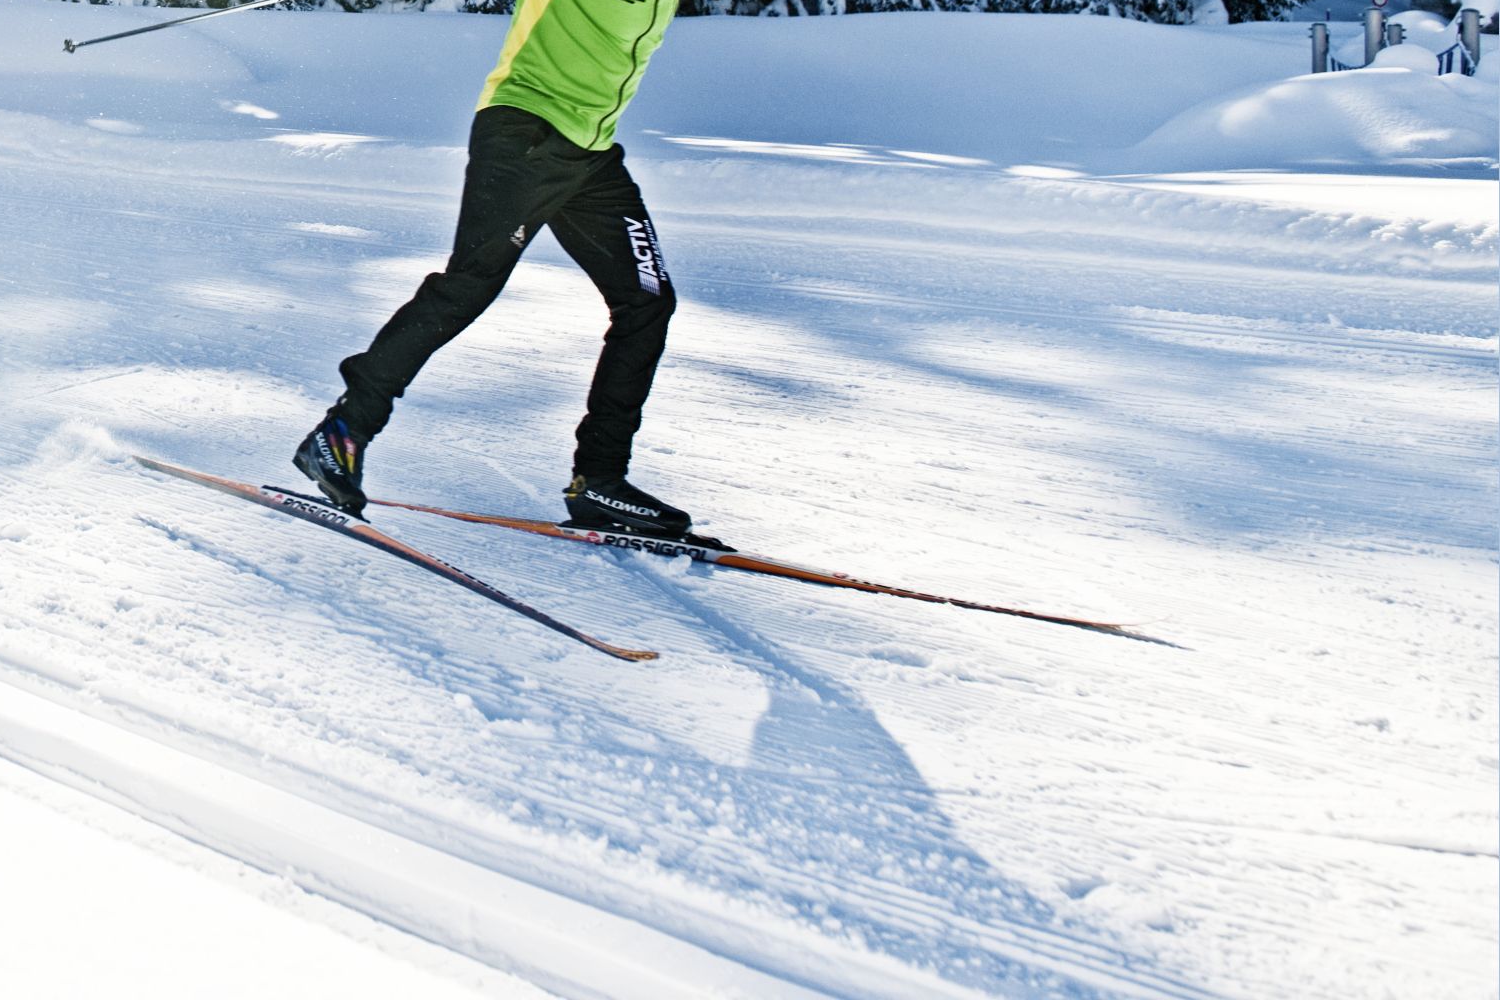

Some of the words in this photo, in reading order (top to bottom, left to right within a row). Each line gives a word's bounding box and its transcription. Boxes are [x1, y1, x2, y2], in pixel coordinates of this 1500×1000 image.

[623, 216, 658, 277] ACTIV
[315, 431, 344, 476] SALOMON
[584, 489, 662, 517] SALOMON
